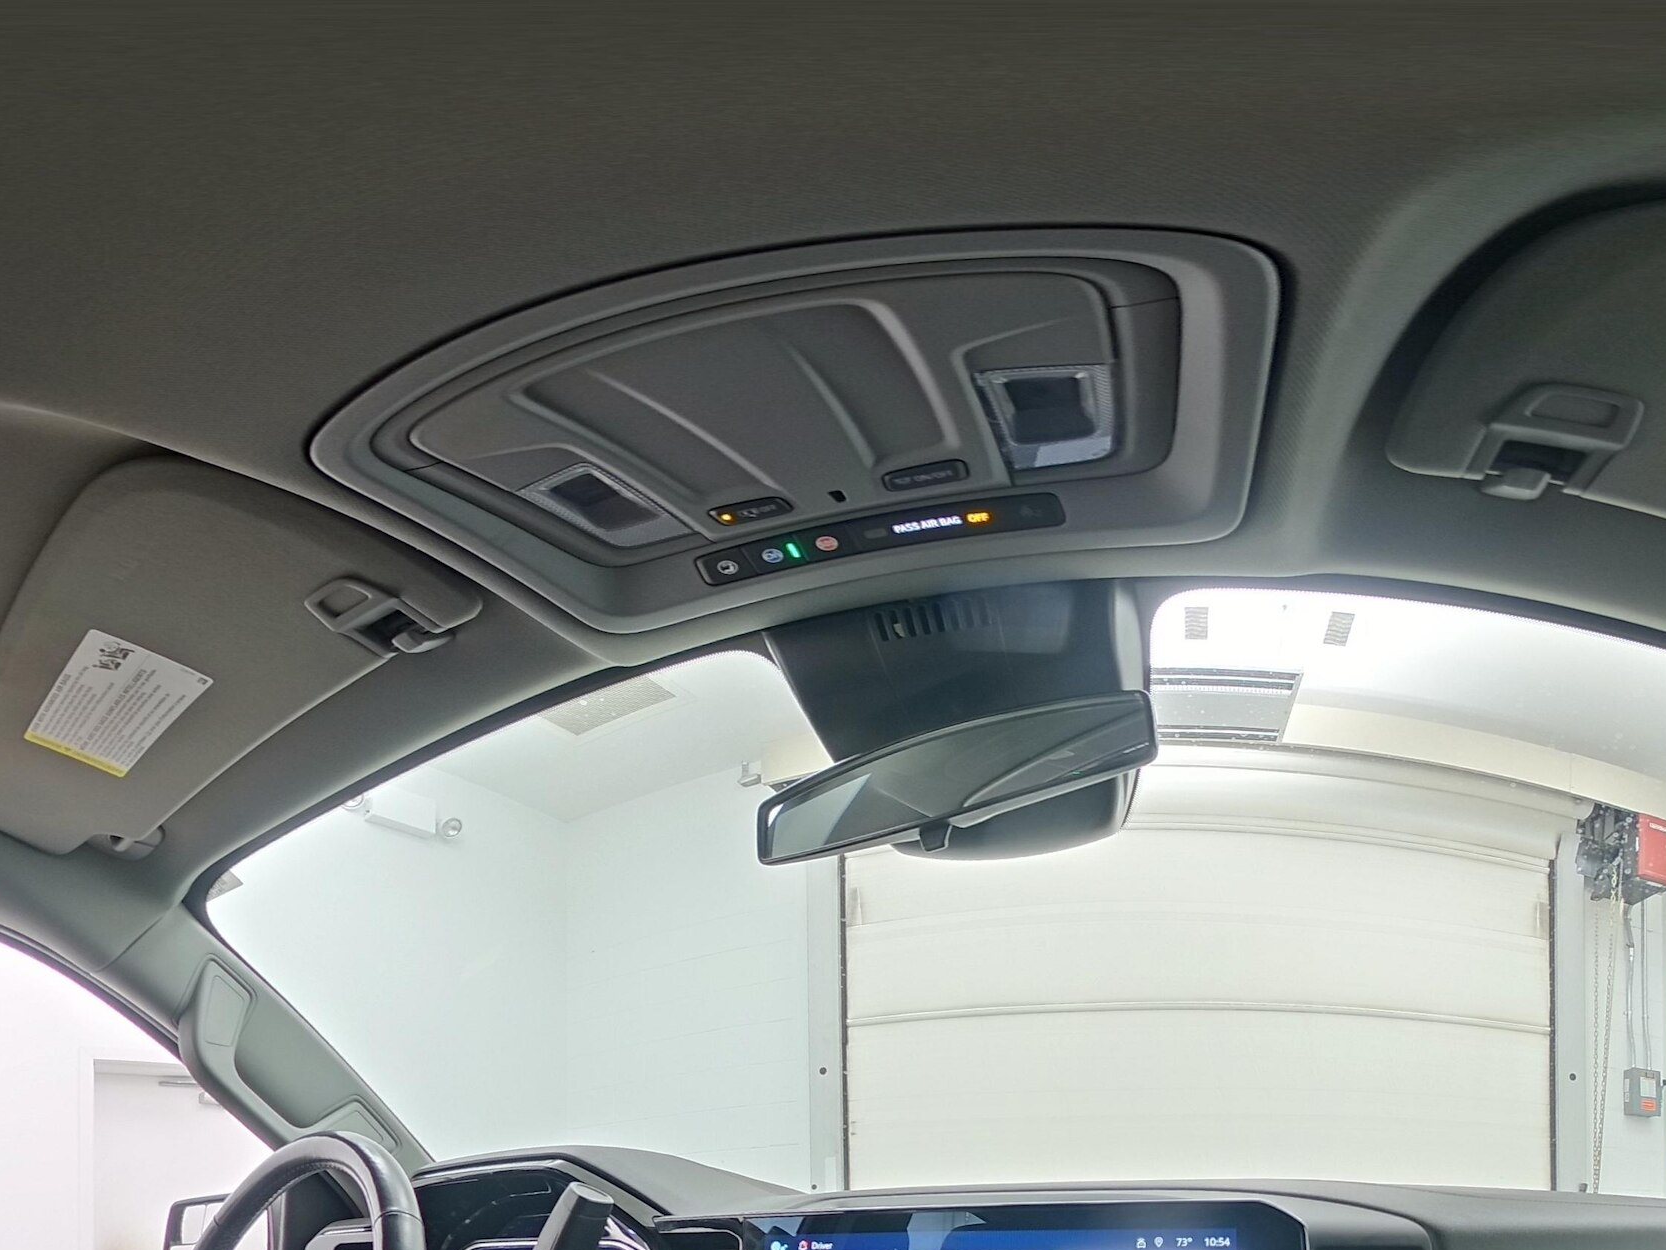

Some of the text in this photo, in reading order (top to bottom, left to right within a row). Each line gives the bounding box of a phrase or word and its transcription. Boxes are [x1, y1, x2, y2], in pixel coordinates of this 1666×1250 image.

[892, 512, 990, 534] PASS AIR BAG OFF
[811, 1241, 833, 1250] Driver
[1204, 1236, 1231, 1248] 10:54
